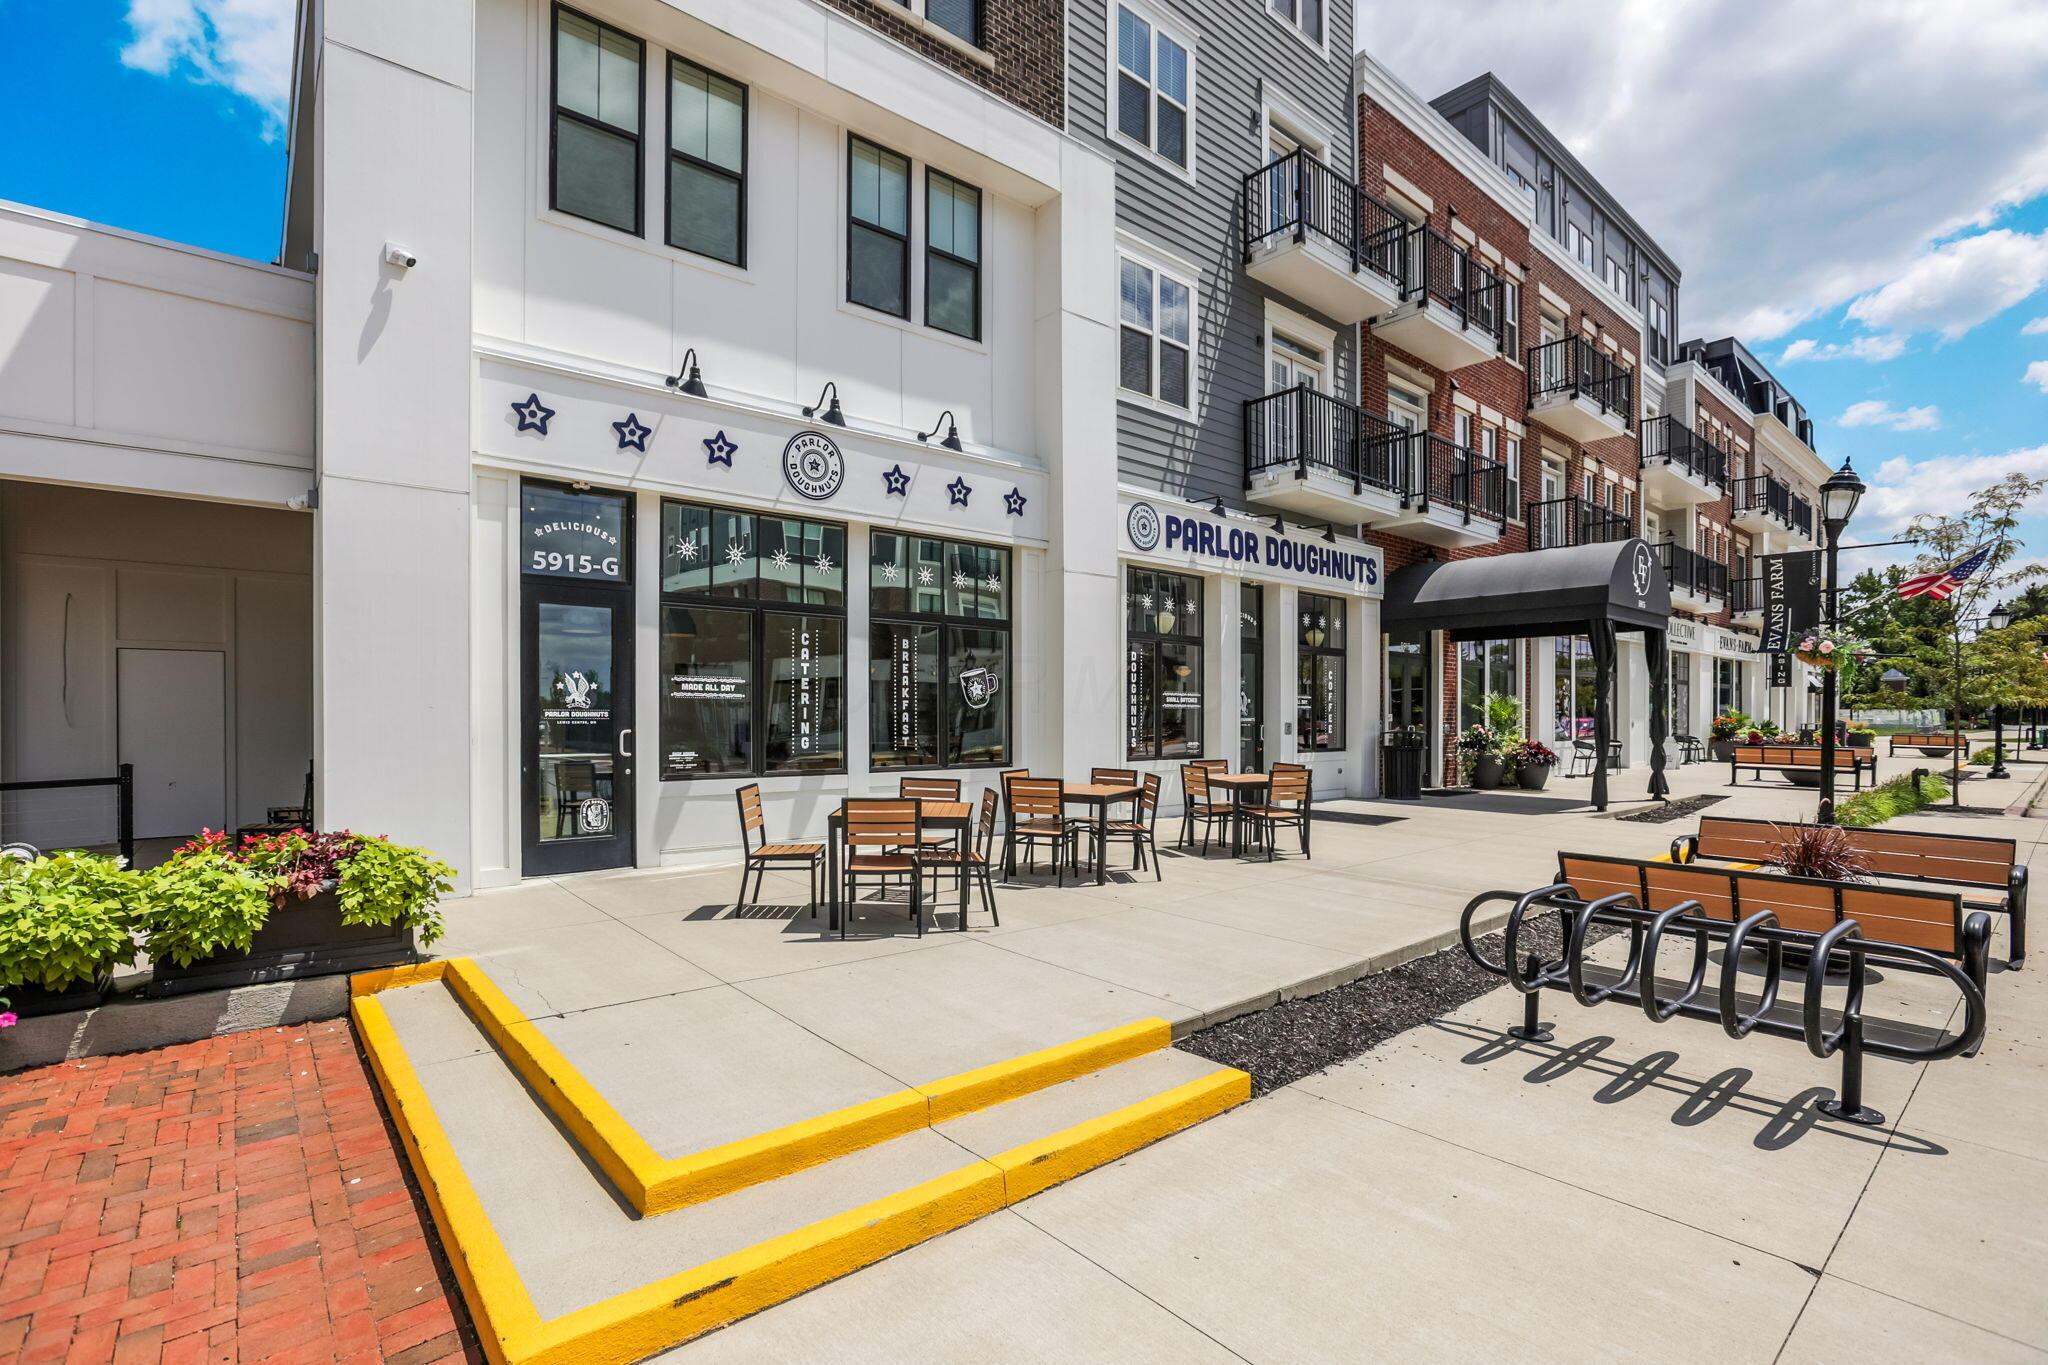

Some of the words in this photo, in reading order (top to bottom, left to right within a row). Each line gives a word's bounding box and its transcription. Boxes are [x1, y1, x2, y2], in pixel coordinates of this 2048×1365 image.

[795, 438, 835, 458] PARLOR
[790, 463, 839, 493] DOUGHNUTS
[544, 522, 609, 540] DELICIOUS
[532, 550, 619, 576] 5915-G
[1165, 514, 1260, 564] PARLOR
[1266, 535, 1377, 585] DOUGHNUTS
[1770, 557, 1784, 599] FARM
[1667, 622, 1696, 640] OLLECTIVE
[1767, 603, 1784, 650] EVANS
[681, 683, 703, 691] MADE
[705, 683, 719, 691] ALL
[720, 684, 736, 692] DAY
[801, 633, 810, 749] CATERING
[901, 638, 910, 747] BREAKFAST
